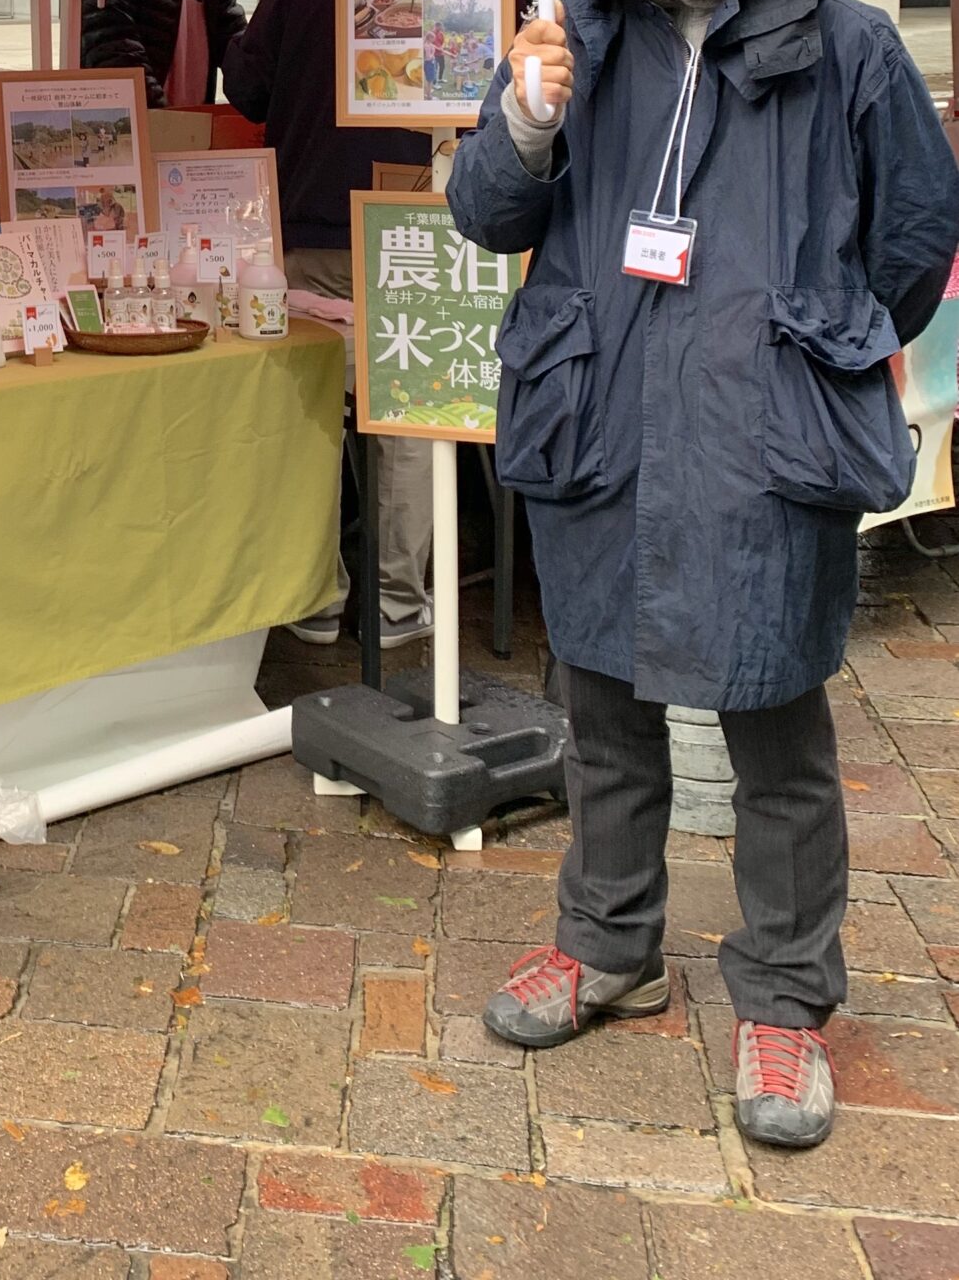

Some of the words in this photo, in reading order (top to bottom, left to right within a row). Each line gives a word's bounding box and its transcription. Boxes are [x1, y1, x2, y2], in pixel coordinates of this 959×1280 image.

[376, 225, 509, 294] 農泊
[383, 290, 504, 311] 岩井ファーム宿泊
